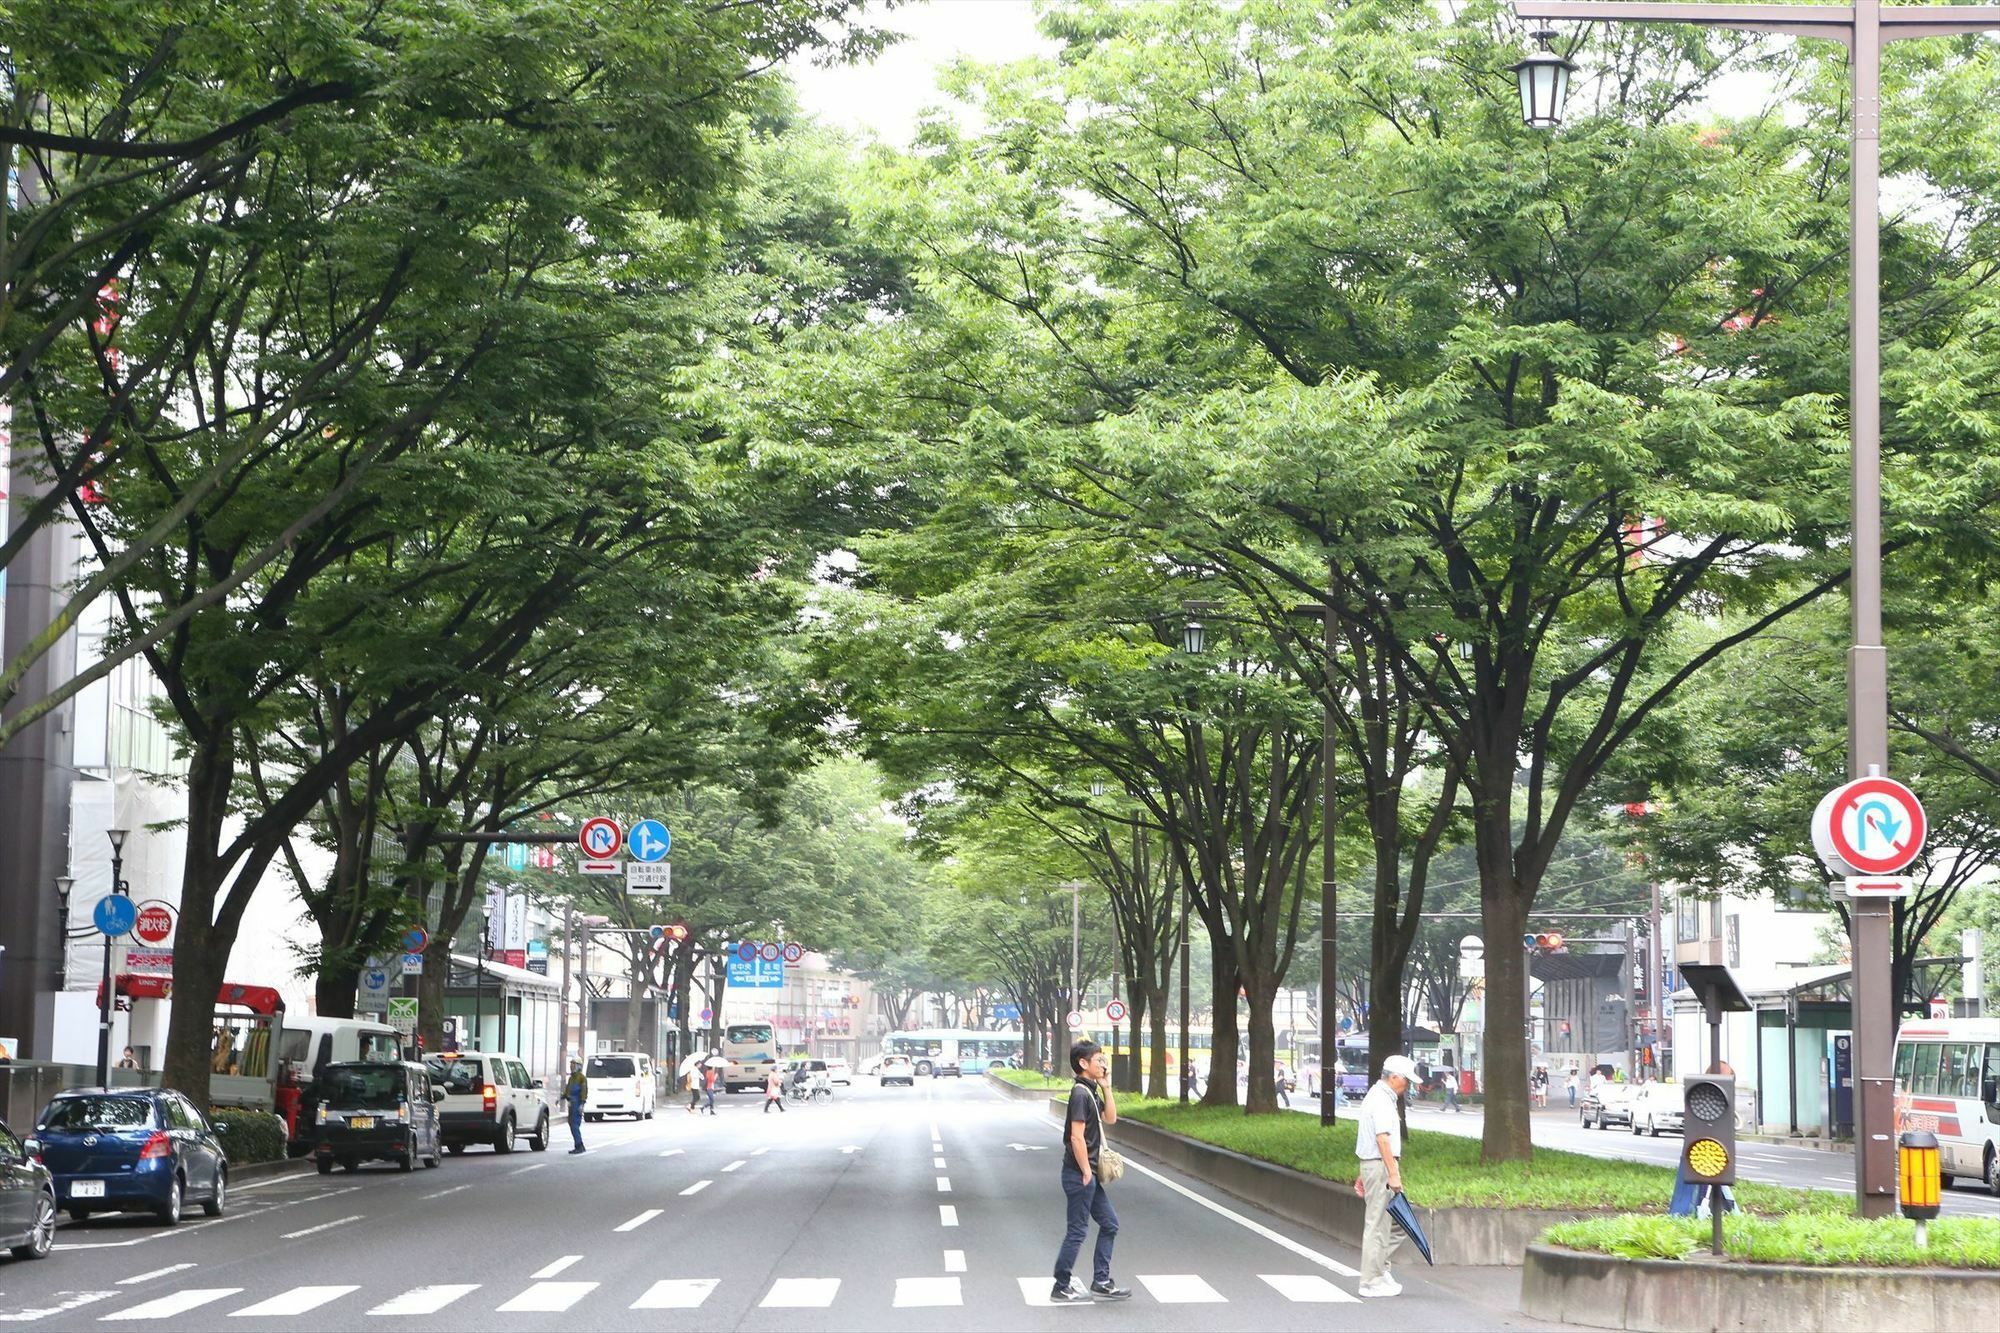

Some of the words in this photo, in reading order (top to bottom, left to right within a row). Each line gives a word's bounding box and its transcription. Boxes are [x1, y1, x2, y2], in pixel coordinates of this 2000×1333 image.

[630, 865, 667, 874] 自転車を除く
[630, 875, 667, 883] 一方通行路
[139, 917, 170, 933] 消火栓
[764, 947, 777, 958] 40
[138, 979, 158, 987] UNIC
